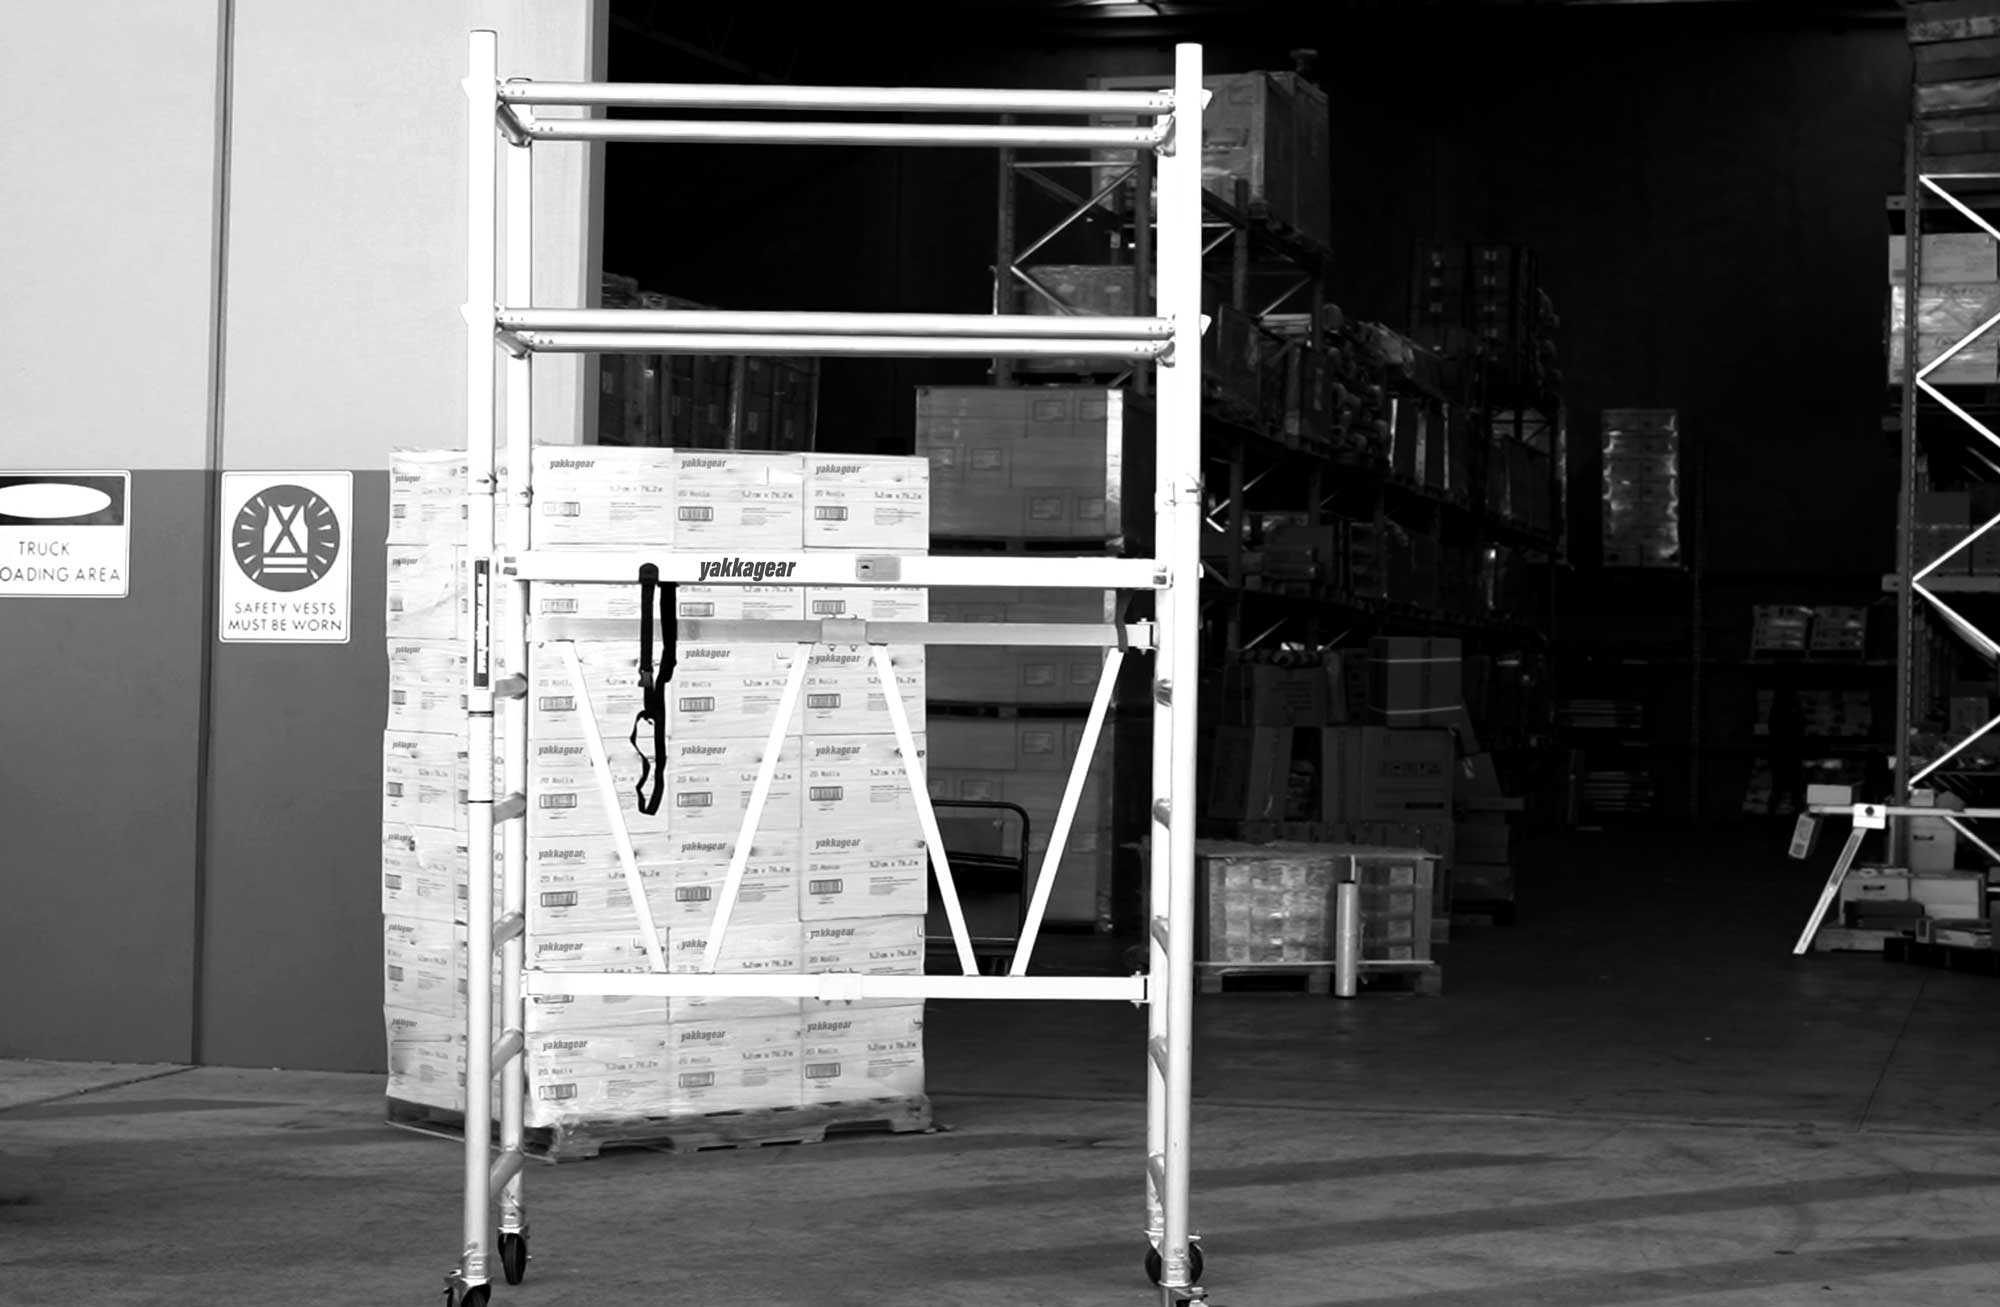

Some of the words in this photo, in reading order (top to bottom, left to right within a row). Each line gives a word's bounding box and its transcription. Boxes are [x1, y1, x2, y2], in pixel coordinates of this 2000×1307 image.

[549, 459, 595, 470] yakkagear
[681, 458, 727, 469] yakkagear
[815, 463, 862, 475] yakkagear
[18, 541, 71, 557] TRUCK
[0, 566, 70, 583] OADING
[74, 566, 121, 583] AREA
[698, 557, 797, 582] yakkagear
[234, 602, 287, 615] SAFETY
[292, 602, 337, 615] VESTS
[227, 619, 267, 632] MUST
[271, 619, 287, 632] BE
[292, 619, 343, 632] WORN
[685, 648, 730, 659] yakkagear
[815, 653, 860, 664] yakkagear
[538, 745, 584, 756] yakkagear
[681, 746, 727, 756] yakkagear
[815, 745, 861, 756] yakkagear
[681, 841, 727, 853] yakkagear
[815, 838, 861, 850] yakkagear
[538, 849, 584, 860] yakkagear
[809, 928, 855, 939] yakkagear
[538, 941, 584, 953] yakkagear
[681, 939, 708, 950] yakka
[806, 1021, 852, 1032] yakkagear
[681, 1031, 726, 1042] yakkagear
[542, 1039, 588, 1050] yakkagear
